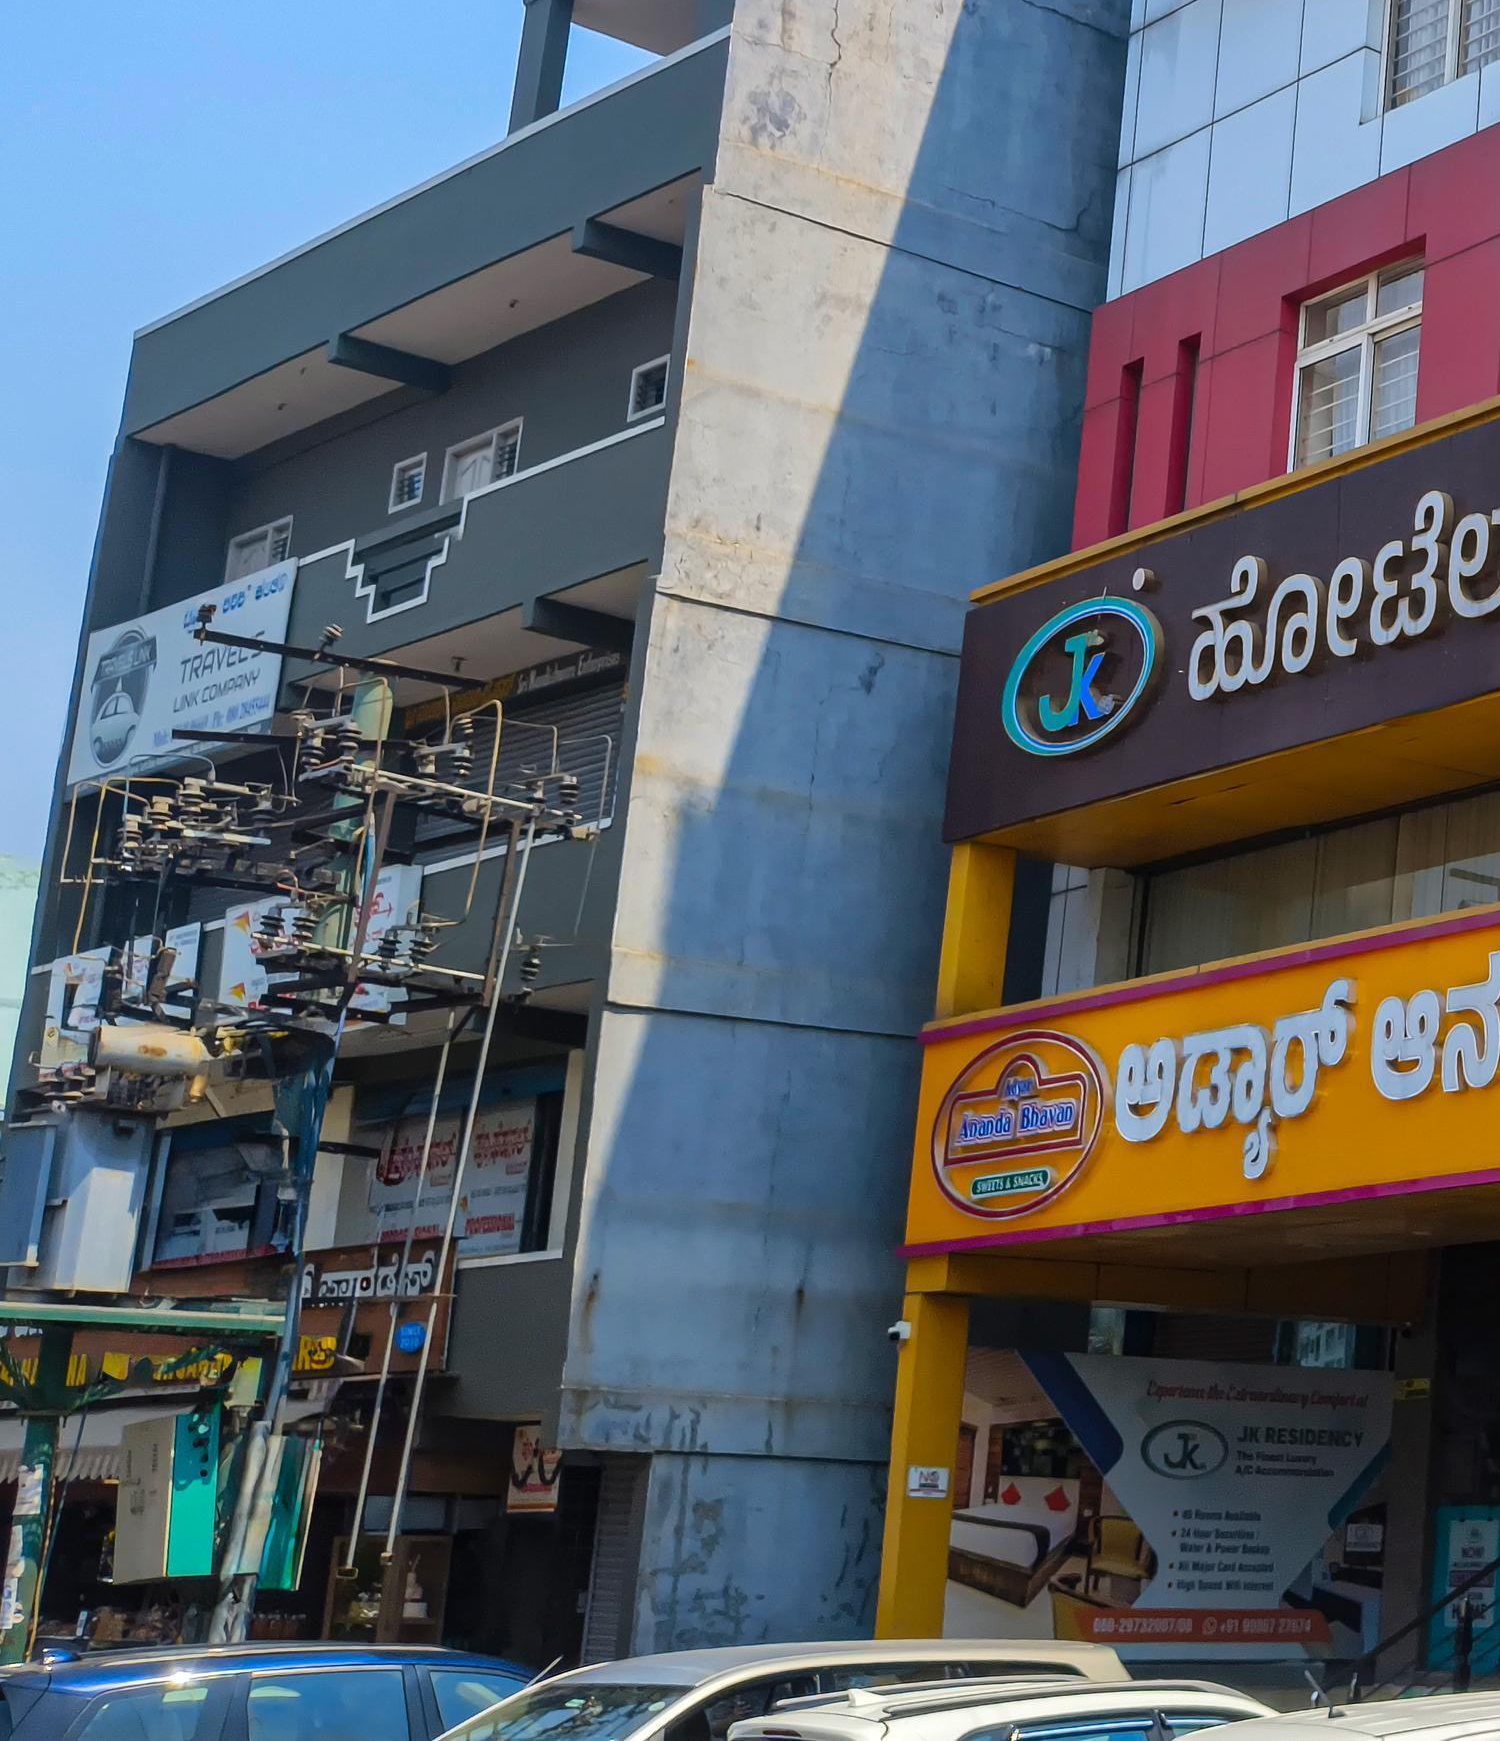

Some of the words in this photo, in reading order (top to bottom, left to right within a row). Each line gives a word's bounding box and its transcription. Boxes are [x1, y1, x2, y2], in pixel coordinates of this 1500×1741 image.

[173, 688, 200, 713] LINK
[201, 669, 260, 703] COMPANY
[1114, 977, 1357, 1180] ಅಡ್ಯಾರ್
[959, 1109, 1012, 1140] Ananda
[1020, 1102, 1074, 1132] Bhavan
[1013, 1171, 1044, 1189] SNACKS
[1237, 1426, 1259, 1443] JK
[1265, 1427, 1364, 1448] RESIDENCY
